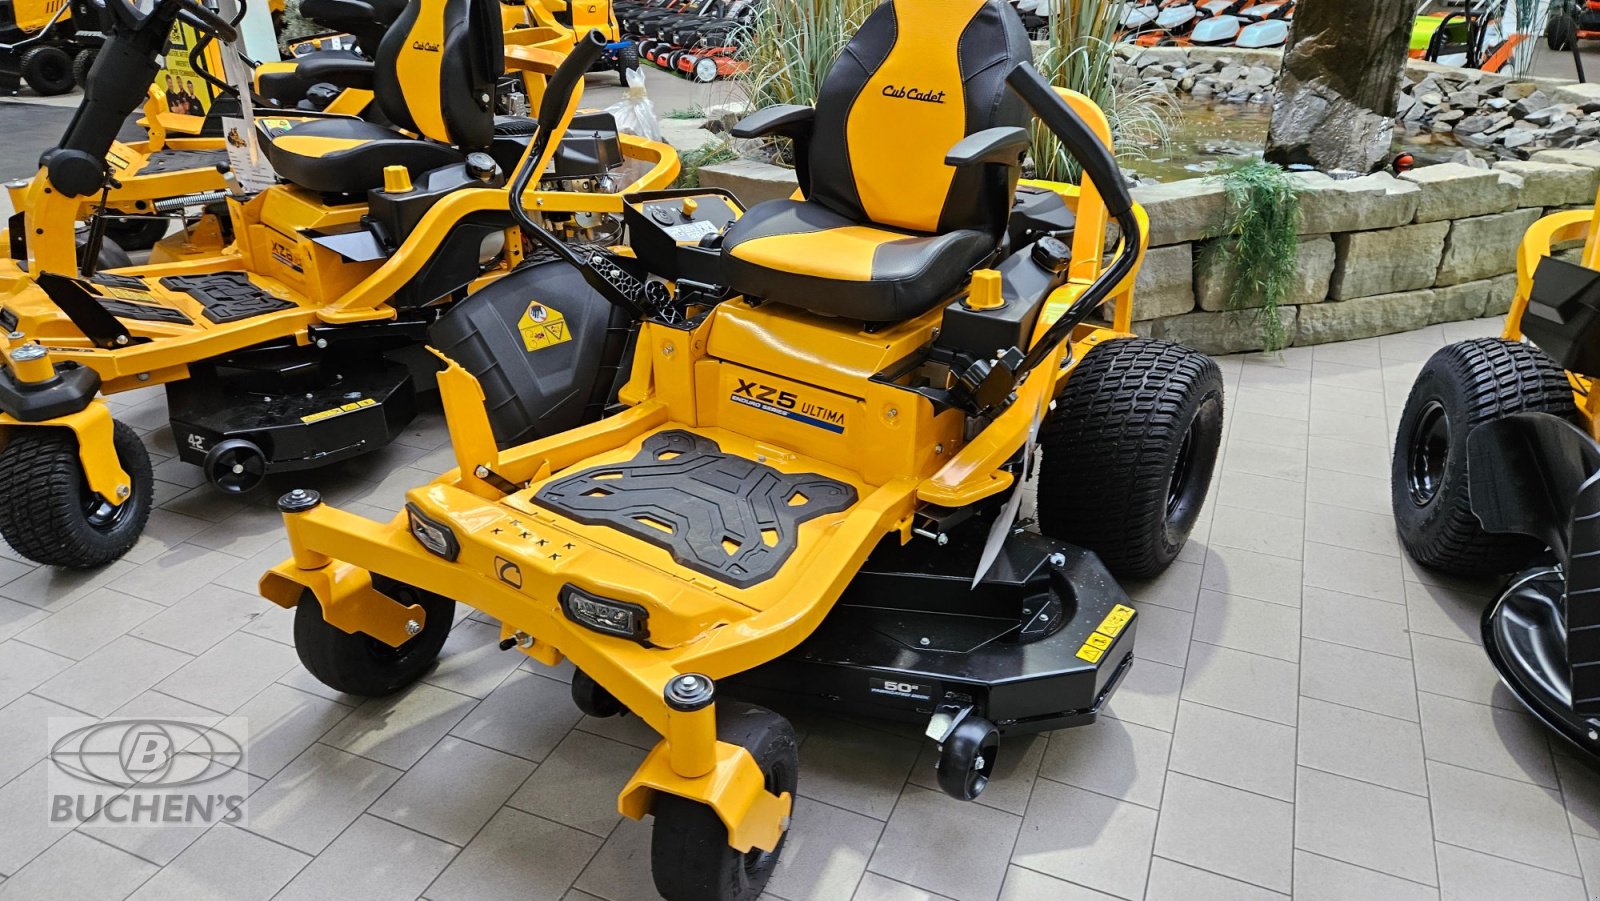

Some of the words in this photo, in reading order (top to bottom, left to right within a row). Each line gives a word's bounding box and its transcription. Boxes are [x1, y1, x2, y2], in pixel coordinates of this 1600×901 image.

[882, 85, 905, 98] Cub
[907, 88, 946, 104] Cadet
[732, 395, 761, 408] ENDURO
[762, 404, 789, 416] SERIES
[733, 378, 798, 409] XZ5
[801, 402, 845, 425] ULTIMA
[884, 681, 919, 693] 50"
